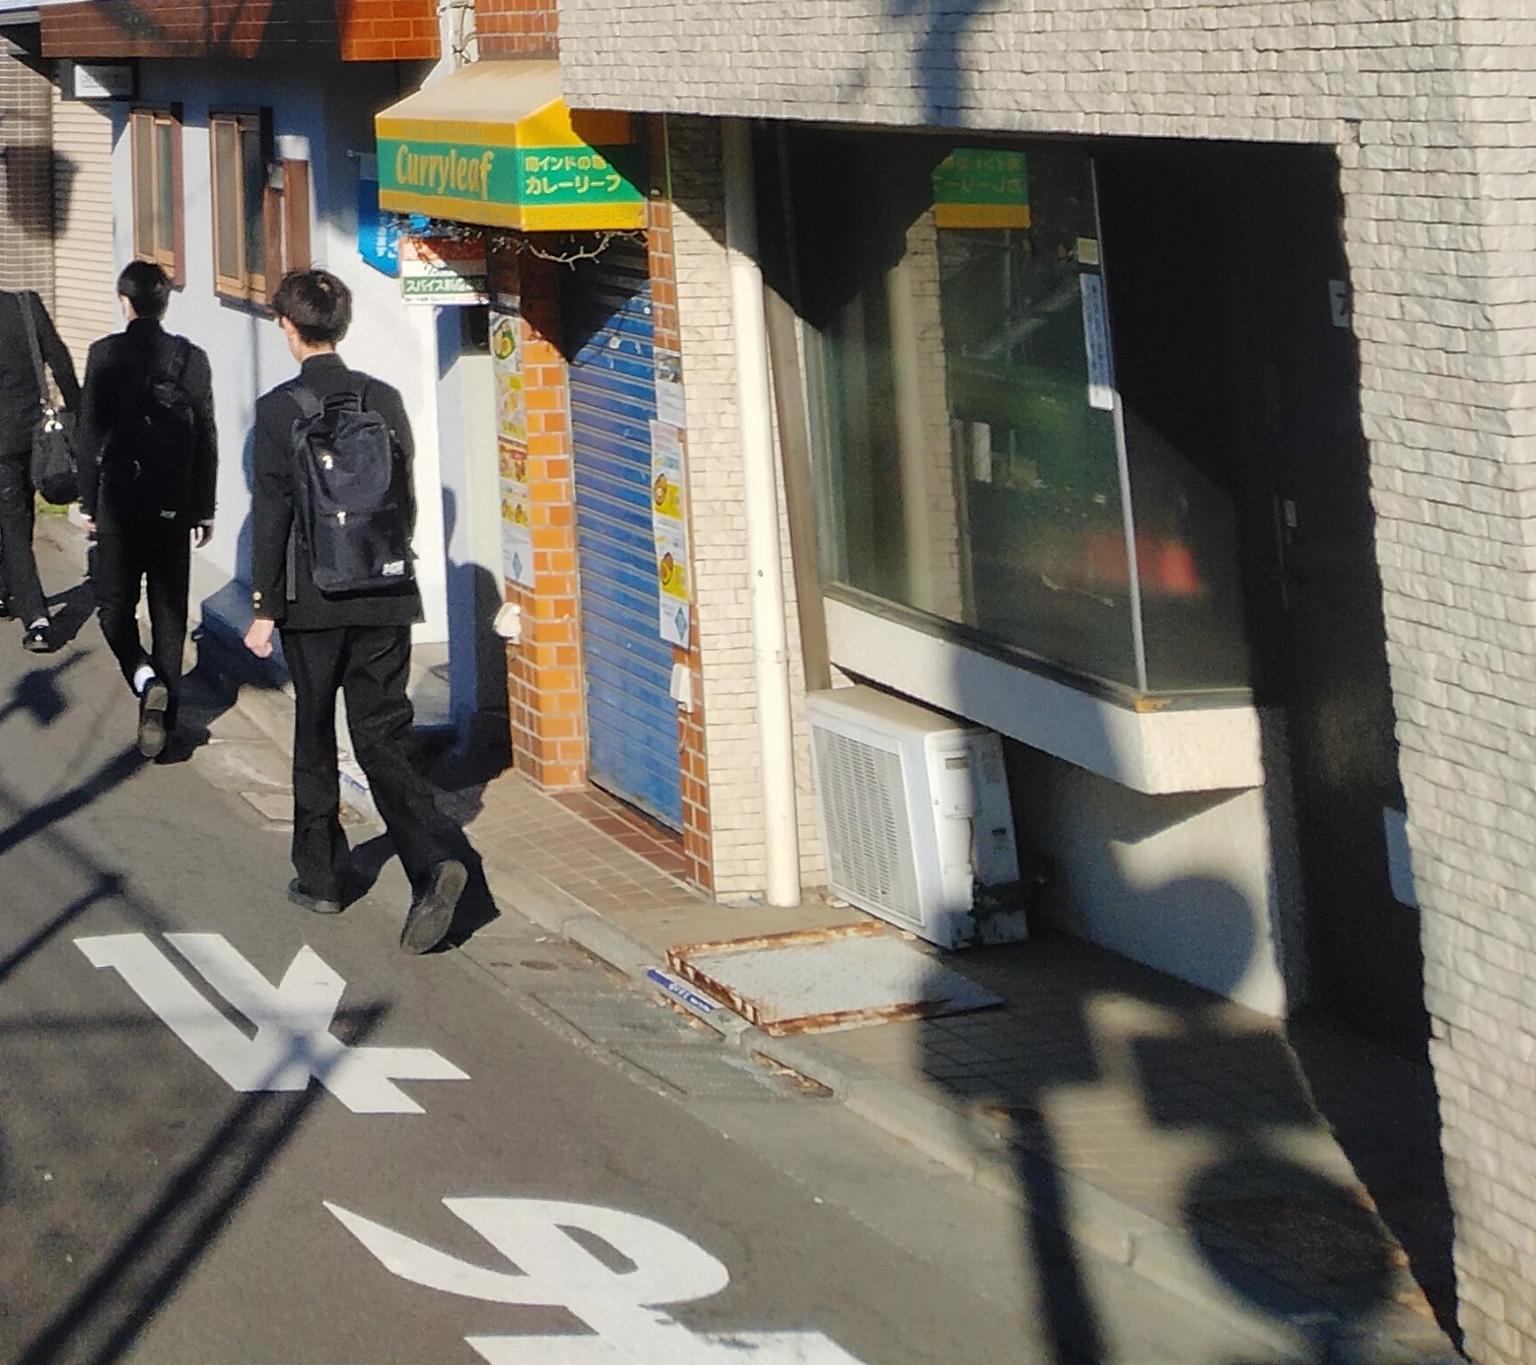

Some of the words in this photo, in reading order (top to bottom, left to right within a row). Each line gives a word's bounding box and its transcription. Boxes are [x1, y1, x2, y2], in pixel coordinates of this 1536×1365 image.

[396, 144, 495, 200] Curryleaf
[526, 175, 622, 195] カレーリーフ
